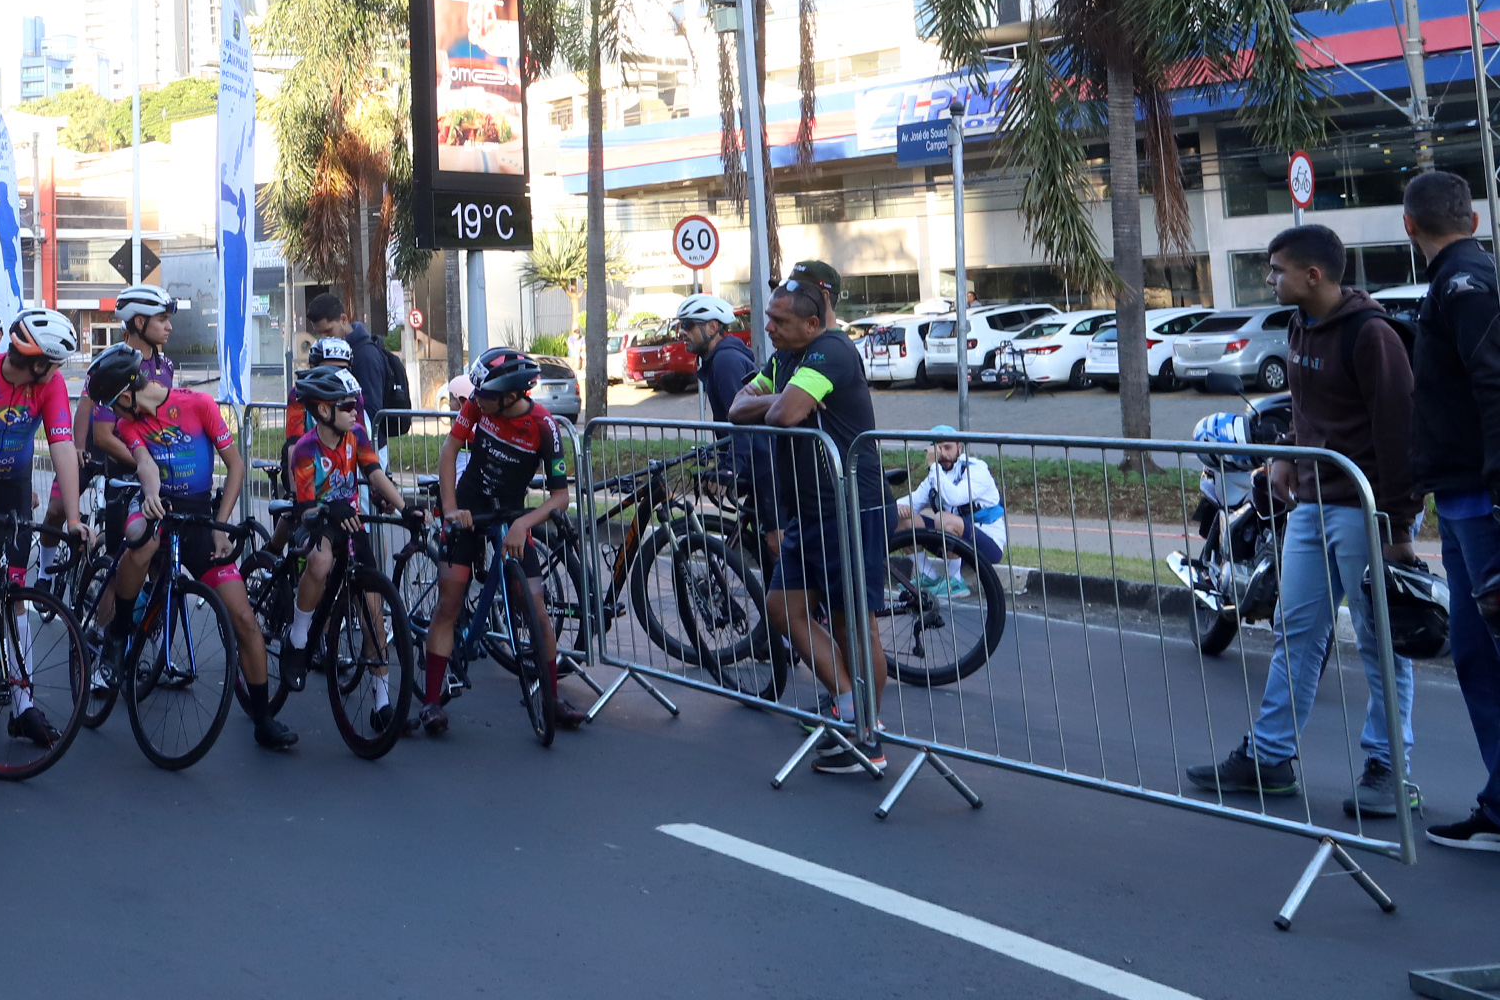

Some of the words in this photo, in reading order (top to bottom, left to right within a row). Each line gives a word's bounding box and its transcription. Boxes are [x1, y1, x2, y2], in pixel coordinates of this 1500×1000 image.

[901, 132, 909, 142] Av.
[910, 129, 922, 141] José
[923, 130, 929, 140] de
[930, 127, 947, 138] Sousa
[925, 139, 948, 152] Campos
[451, 203, 514, 240] 19°C
[681, 228, 711, 251] 60
[174, 470, 195, 478] Brasil
